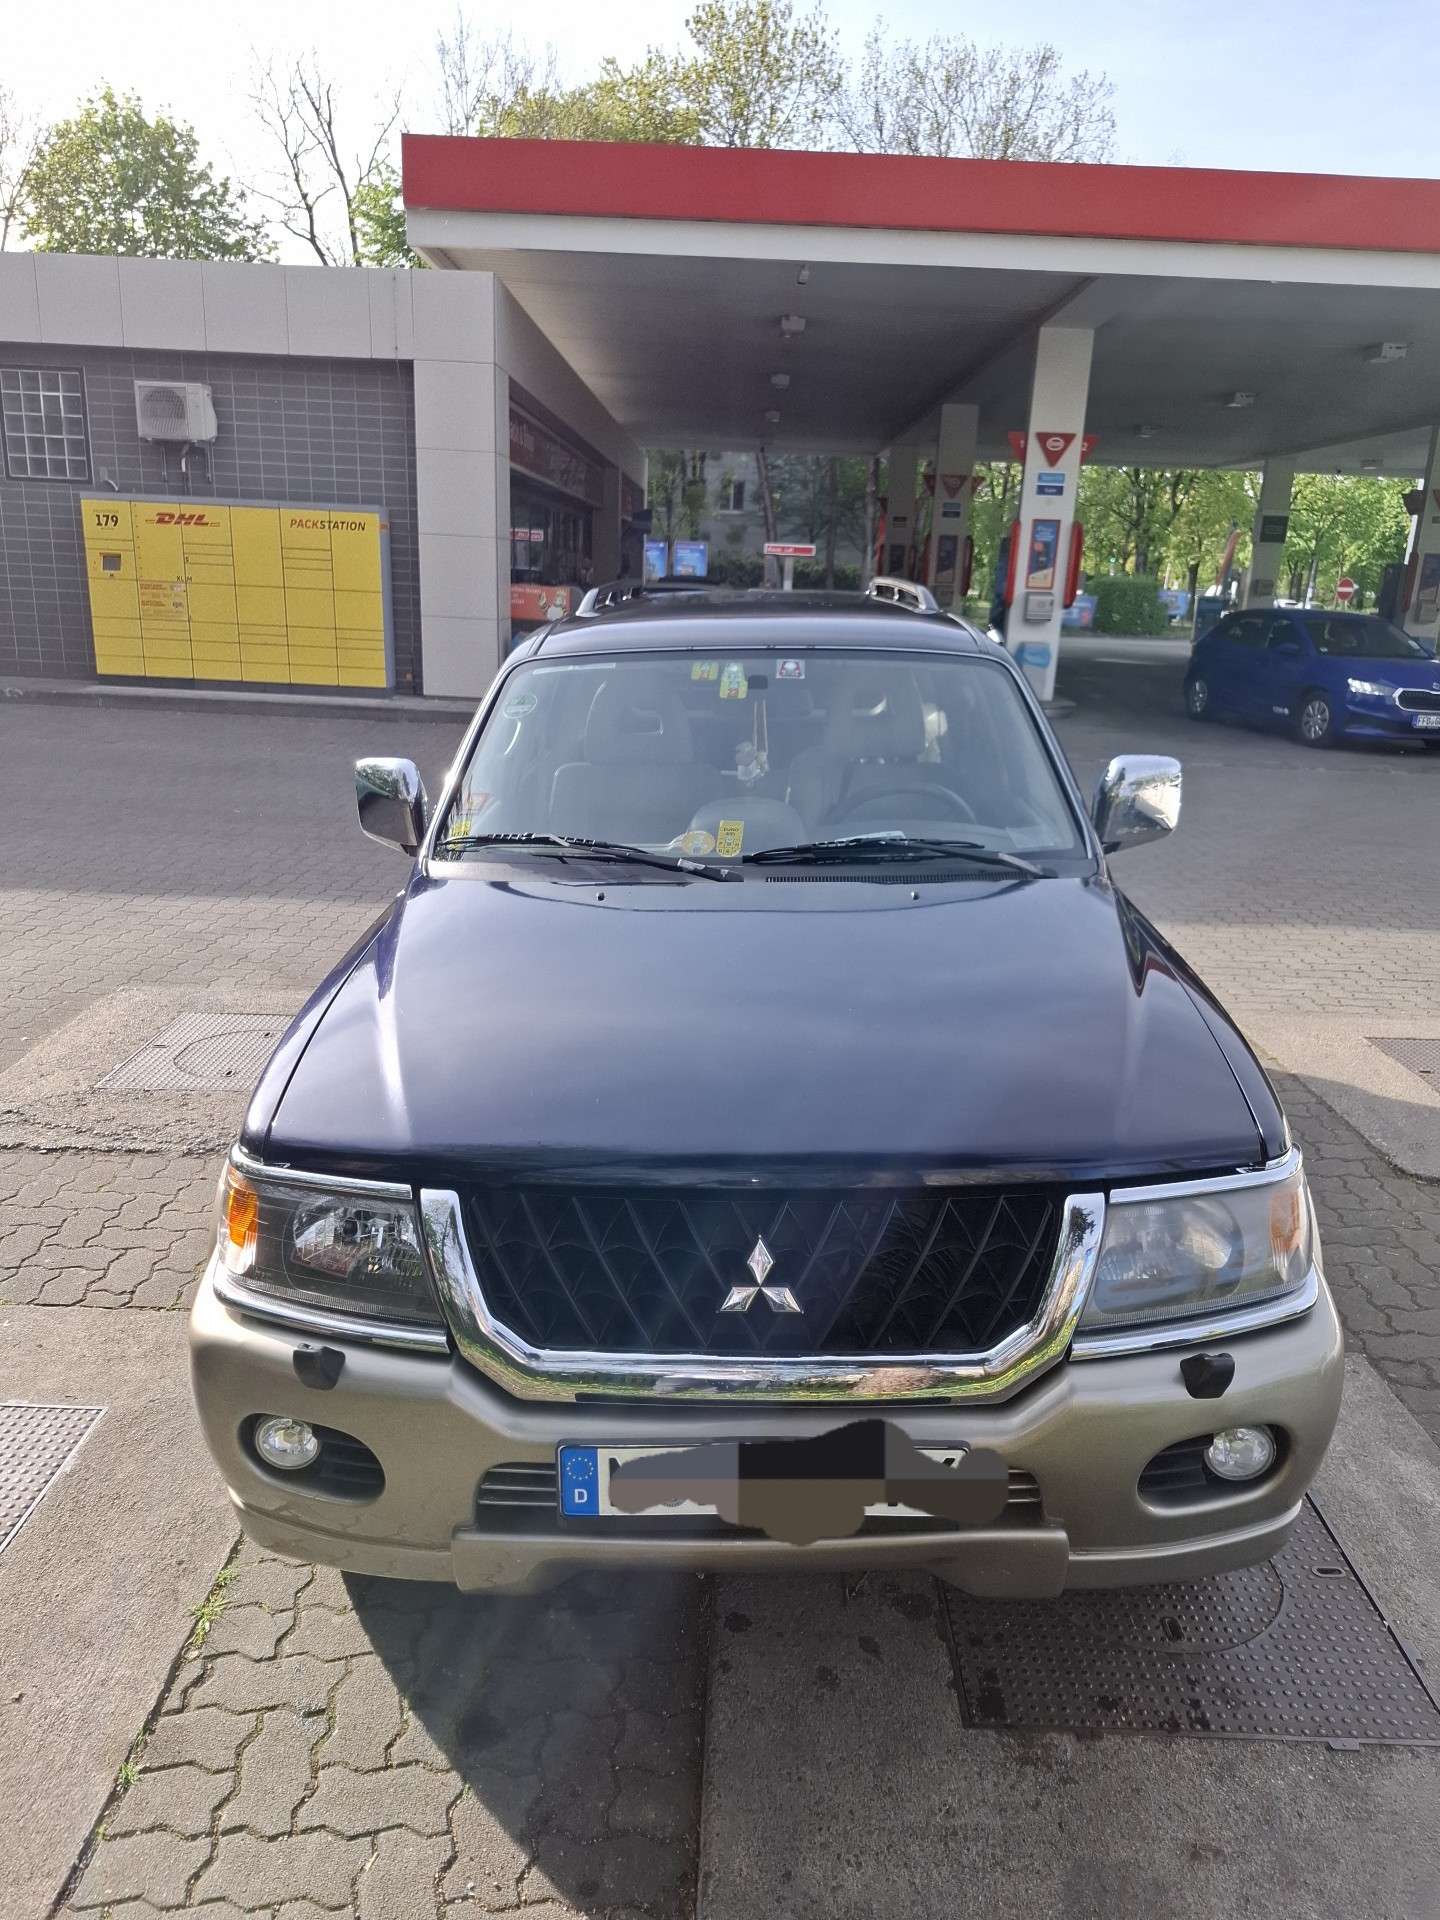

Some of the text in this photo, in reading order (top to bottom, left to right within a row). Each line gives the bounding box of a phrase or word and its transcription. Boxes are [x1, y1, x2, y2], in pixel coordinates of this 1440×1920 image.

[95, 513, 119, 528] 179
[155, 511, 209, 528] DHL
[289, 518, 367, 532] PACKSTATION
[574, 1488, 588, 1503] D
